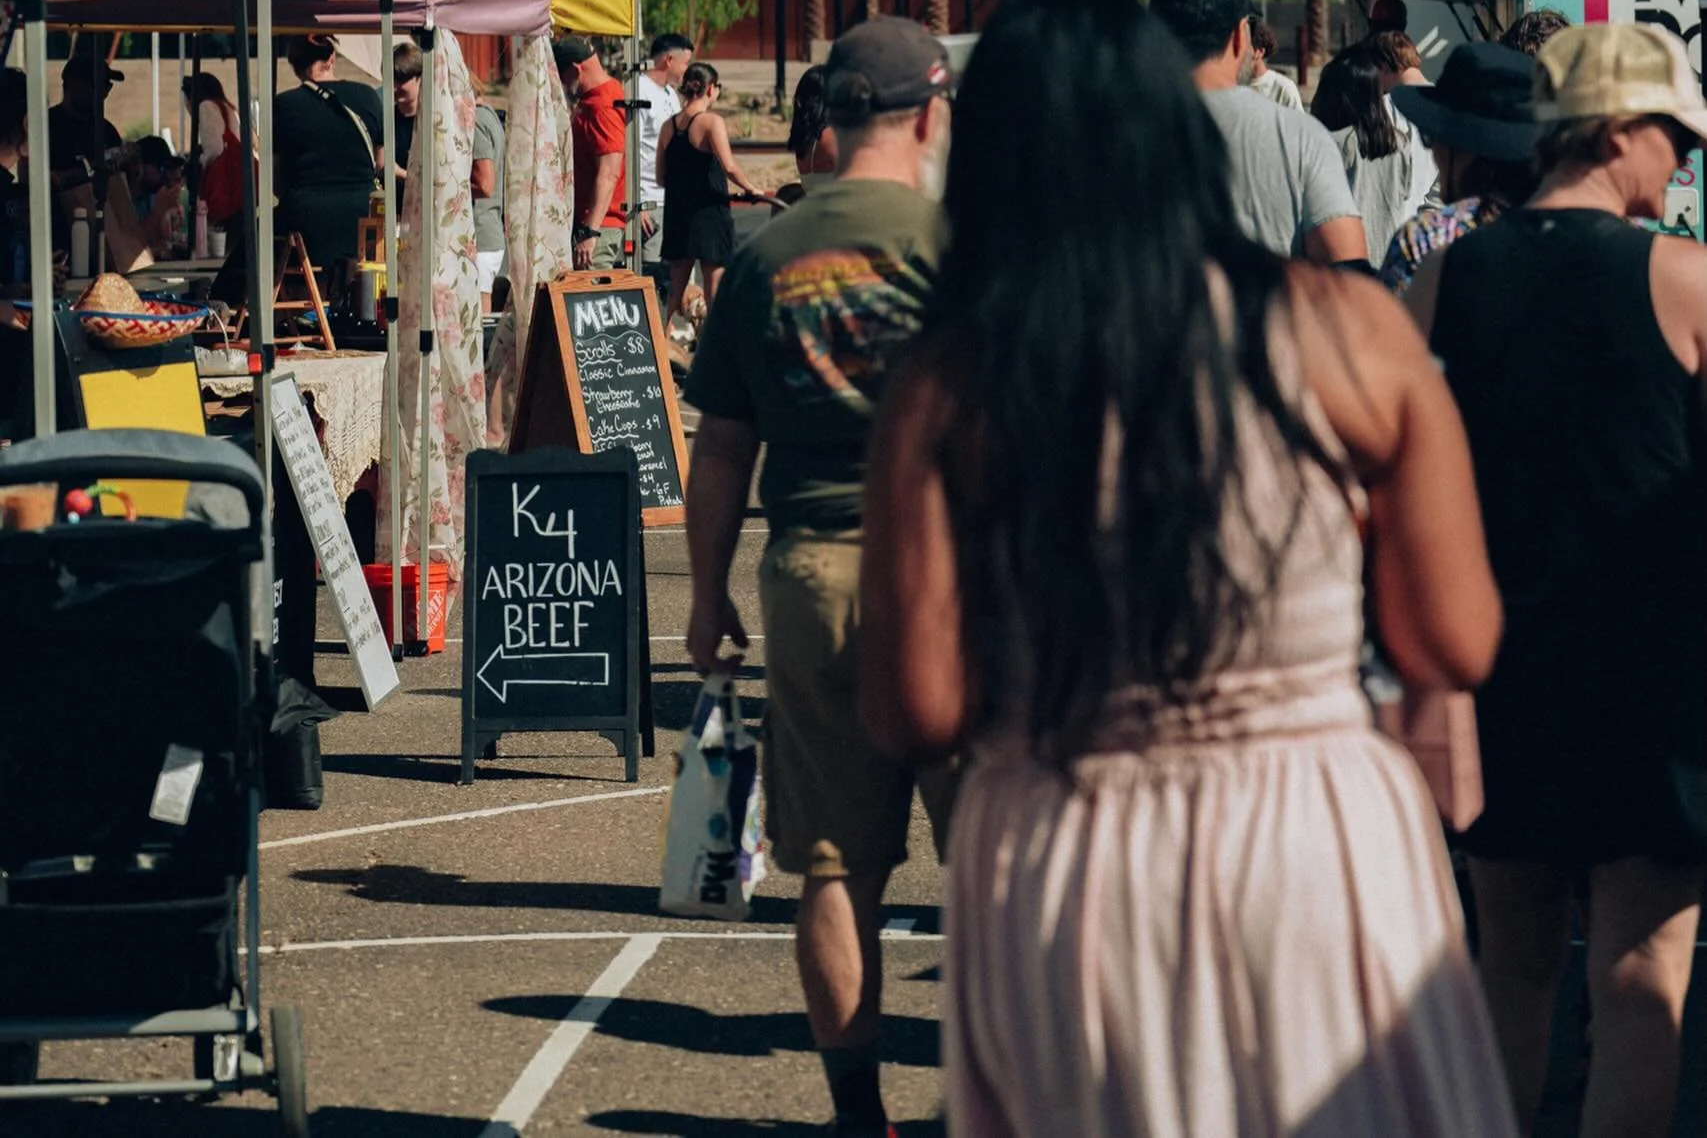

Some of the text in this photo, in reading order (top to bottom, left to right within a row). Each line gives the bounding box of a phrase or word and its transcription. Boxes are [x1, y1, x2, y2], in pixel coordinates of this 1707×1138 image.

[574, 295, 640, 336] MENU
[575, 340, 616, 362] Scrolls
[579, 366, 614, 382] Classic
[581, 385, 634, 404] Strawberry
[638, 455, 668, 472] aramel
[512, 482, 577, 559] K4
[482, 559, 622, 600] ARIZONA
[504, 601, 594, 649] BEEF
